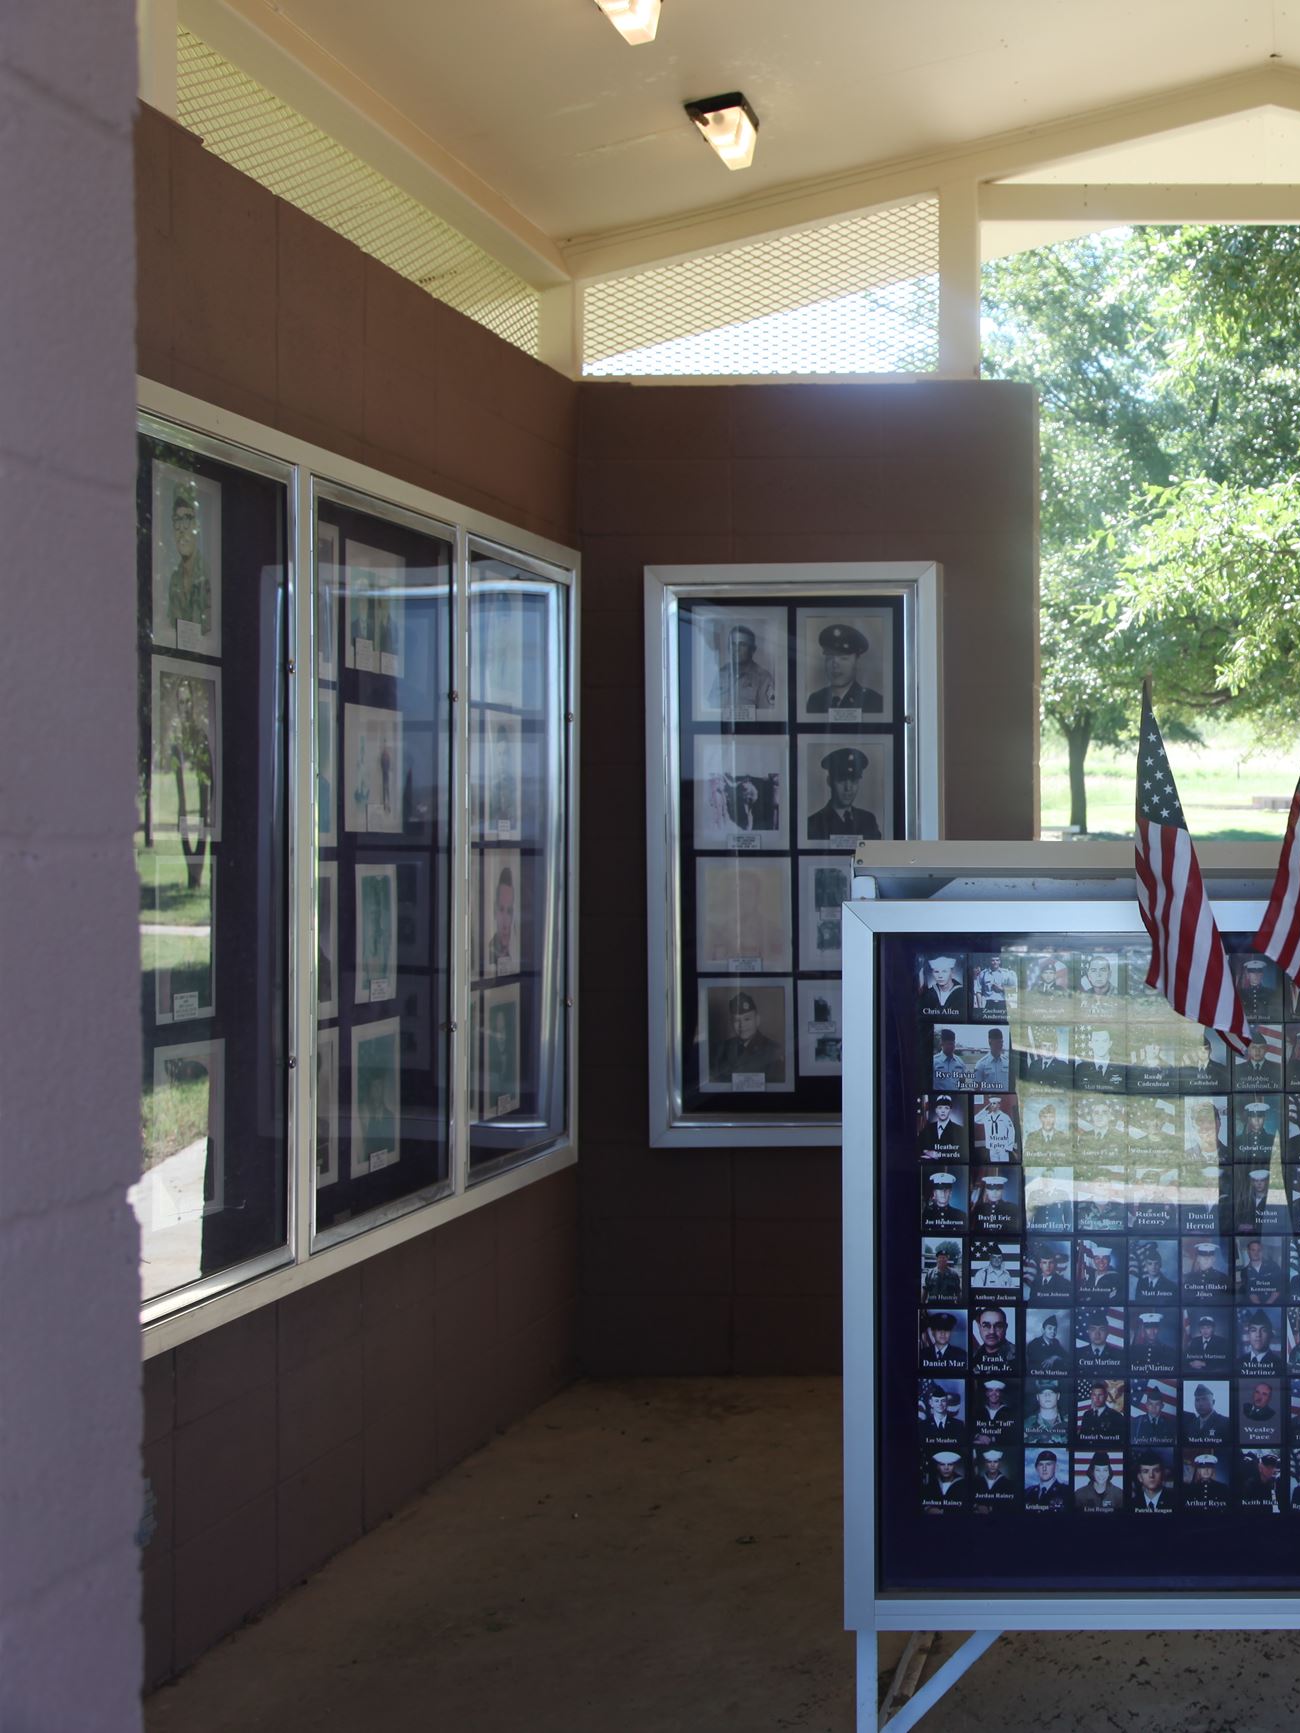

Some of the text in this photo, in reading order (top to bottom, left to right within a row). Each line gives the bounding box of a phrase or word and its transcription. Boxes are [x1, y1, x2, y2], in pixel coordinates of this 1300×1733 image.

[1049, 1222, 1071, 1230] Henry
[1103, 1217, 1123, 1227] Henry
[1079, 1358, 1120, 1367] Cruz Martinez
[976, 1364, 1000, 1372] Marin,
[1244, 1427, 1275, 1435] Wesley
[1096, 1505, 1114, 1514] Reagan
